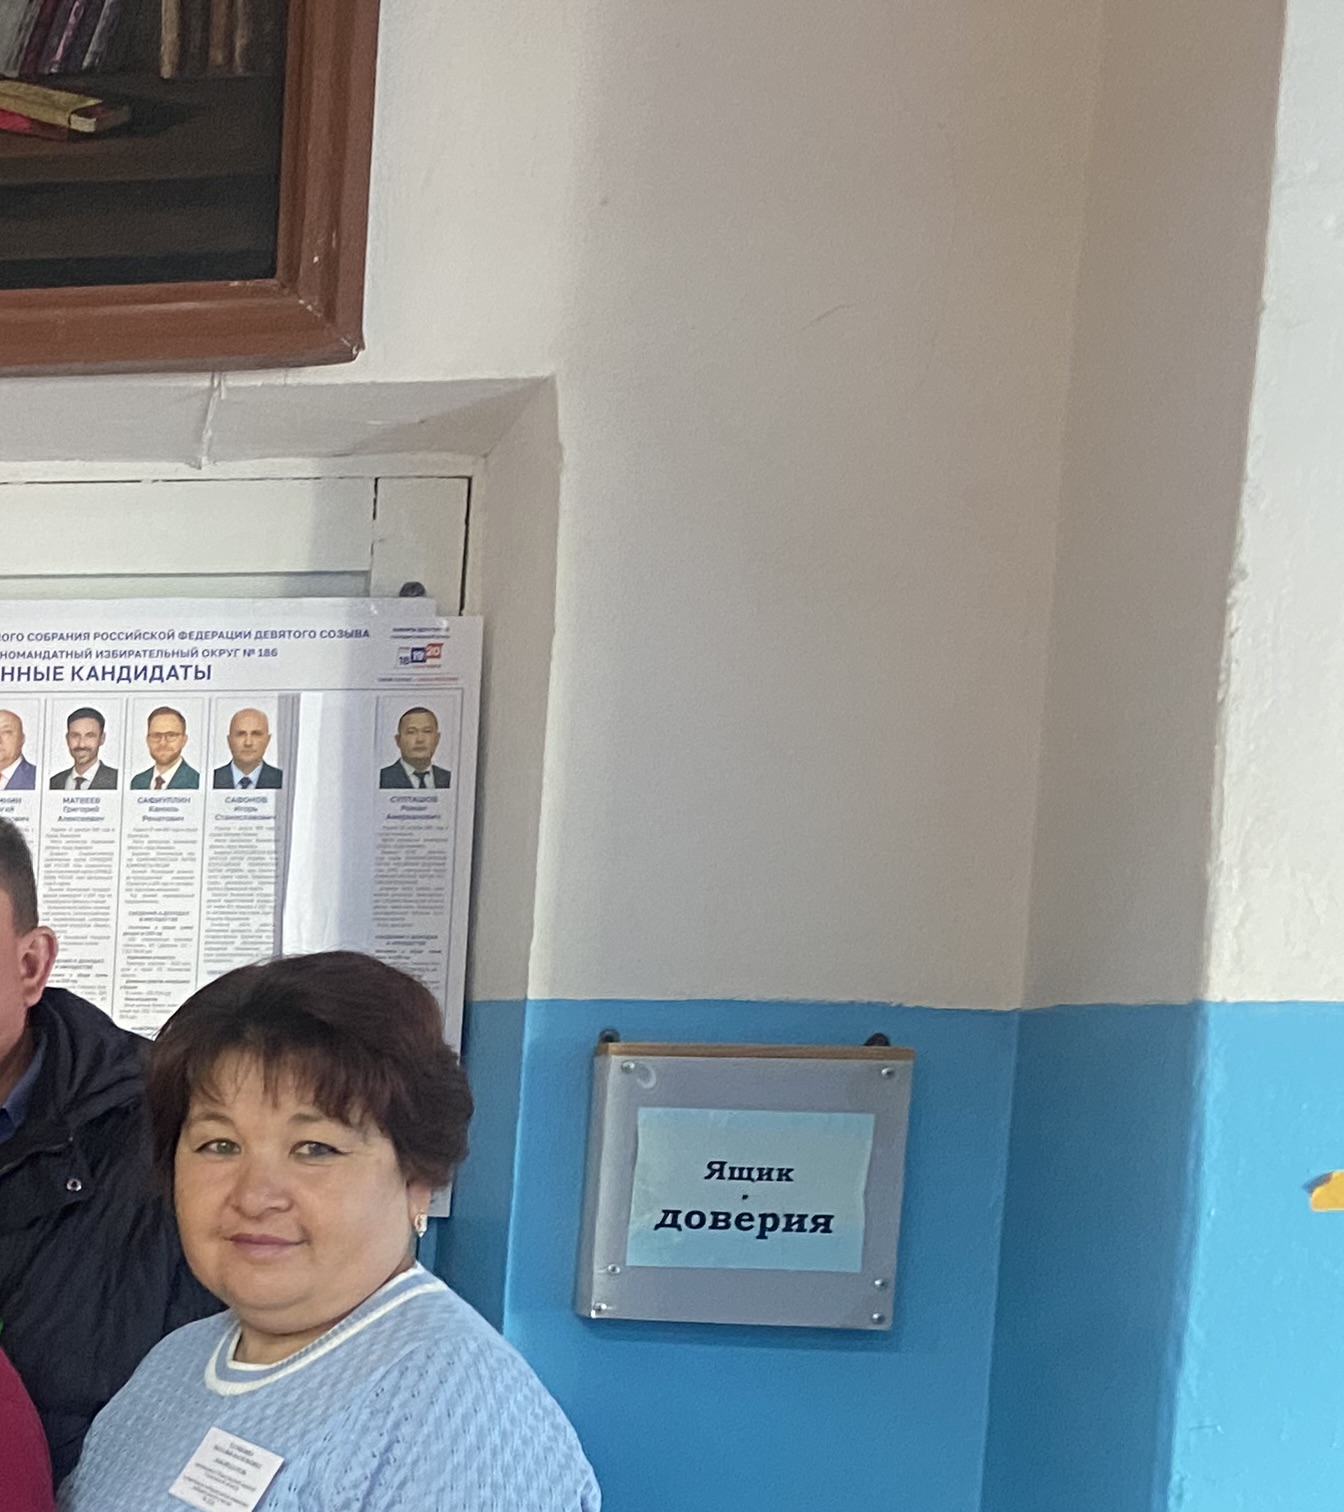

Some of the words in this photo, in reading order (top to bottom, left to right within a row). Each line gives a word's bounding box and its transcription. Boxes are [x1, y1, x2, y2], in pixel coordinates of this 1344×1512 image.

[27, 631, 90, 642] СОБРАНИЯ
[93, 629, 175, 641] РОССИЙСКОЙ
[178, 630, 252, 641] ФЕДЕРАЦИИ
[254, 629, 316, 641] ДЕВЯТОГО
[319, 628, 370, 639] СОЗЫВА
[95, 647, 199, 659] ИЗБИРАТЕЛЬНЫЙ
[201, 648, 240, 658] ОКРУГ
[258, 648, 278, 658] 186
[71, 664, 212, 683] КАНДИДАТЫ
[704, 1160, 794, 1183] Ящик
[653, 1209, 835, 1240] доверия
